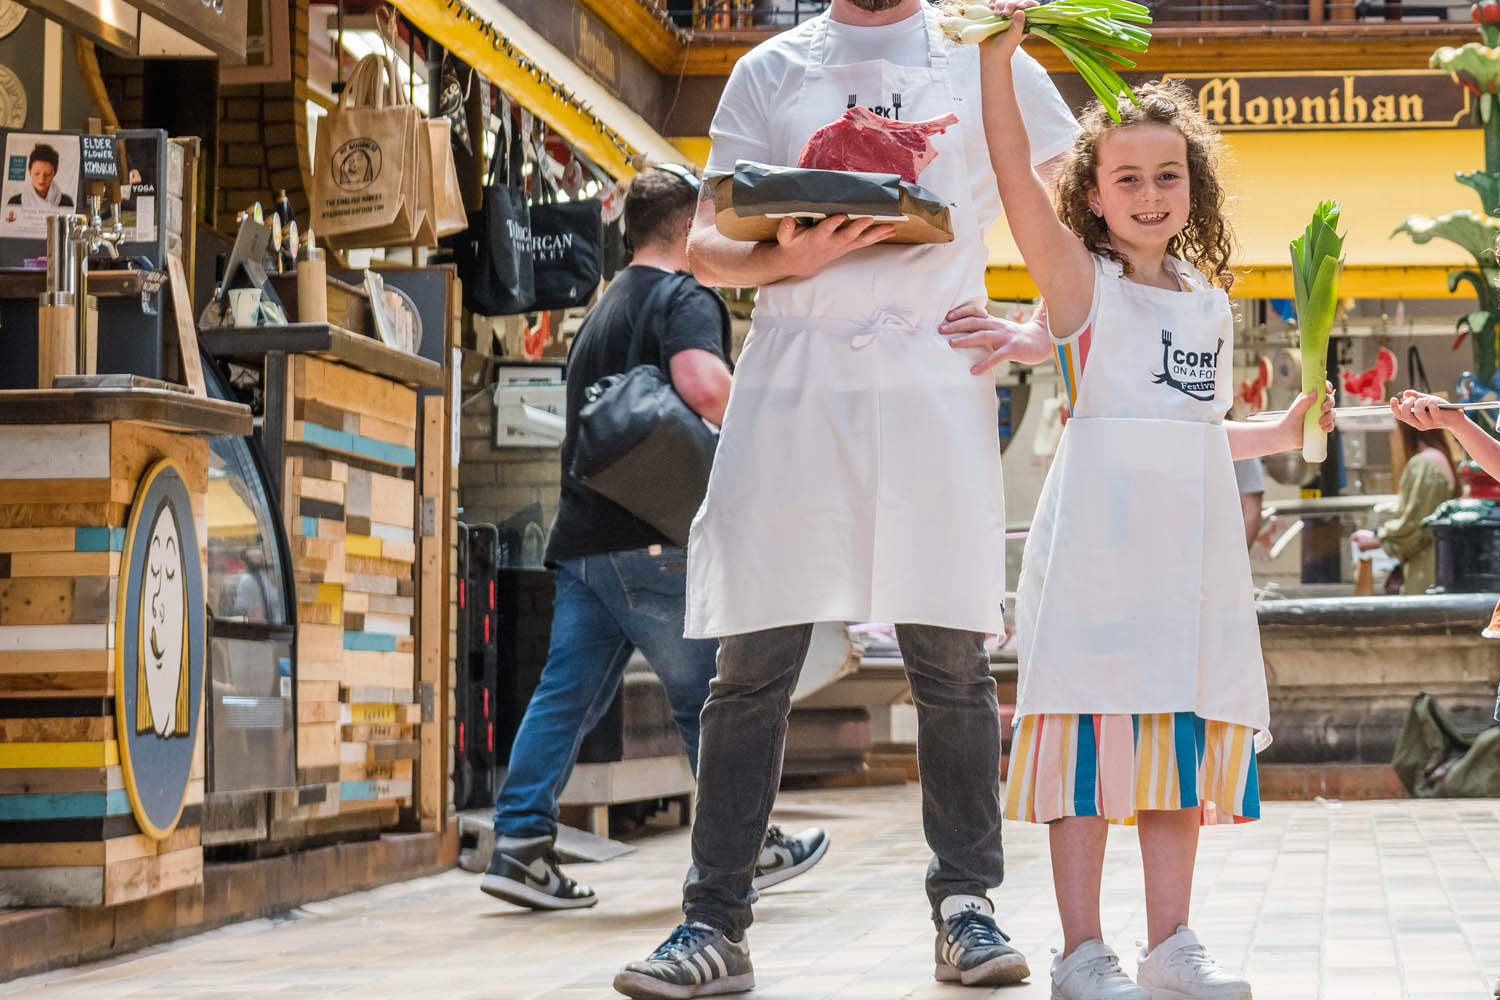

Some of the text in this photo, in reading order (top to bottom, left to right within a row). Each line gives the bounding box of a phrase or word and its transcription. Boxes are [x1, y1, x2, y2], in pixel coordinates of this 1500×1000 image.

[1198, 76, 1425, 126] Moynihan
[83, 137, 112, 150] ELDER
[132, 184, 155, 193] YOGA
[532, 232, 573, 250] RCAN
[1173, 365, 1188, 376] ON
[1189, 369, 1197, 378] A
[1180, 382, 1216, 391] Festiva
